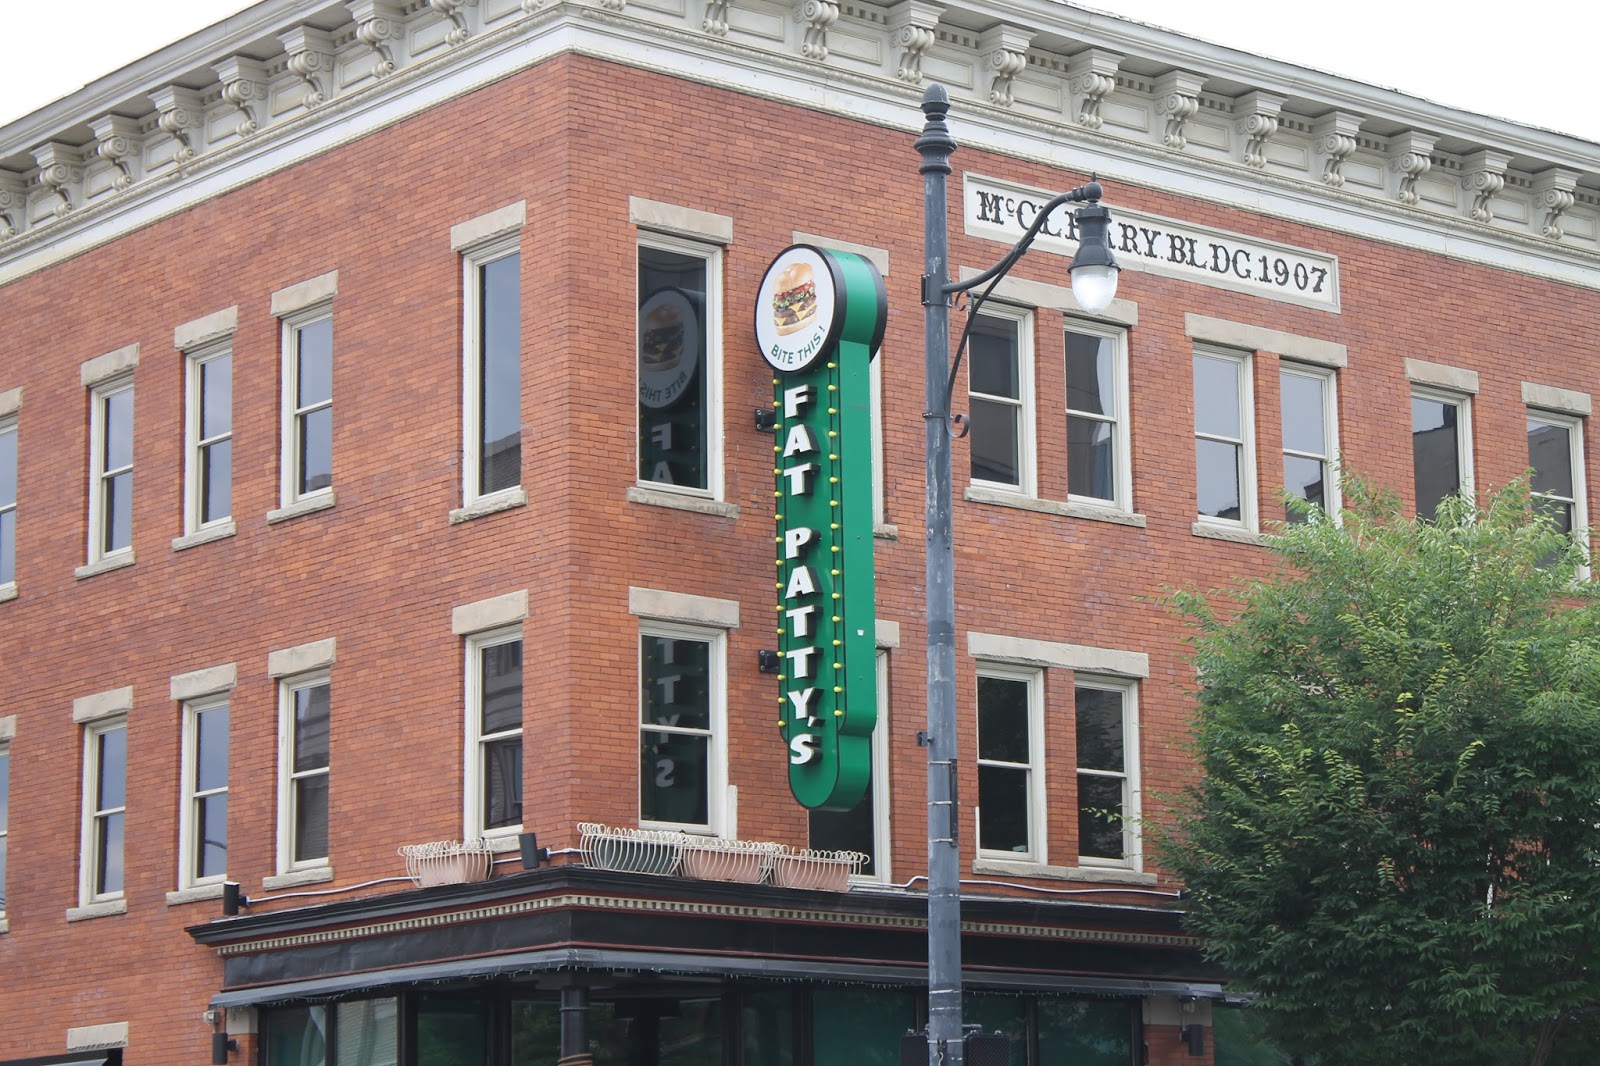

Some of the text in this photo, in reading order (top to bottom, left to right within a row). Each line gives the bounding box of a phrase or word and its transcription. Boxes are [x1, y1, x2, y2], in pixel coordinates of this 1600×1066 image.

[1259, 255, 1328, 293] 1907
[770, 344, 795, 364] BITE
[783, 384, 817, 765] FAT PATTY'S
